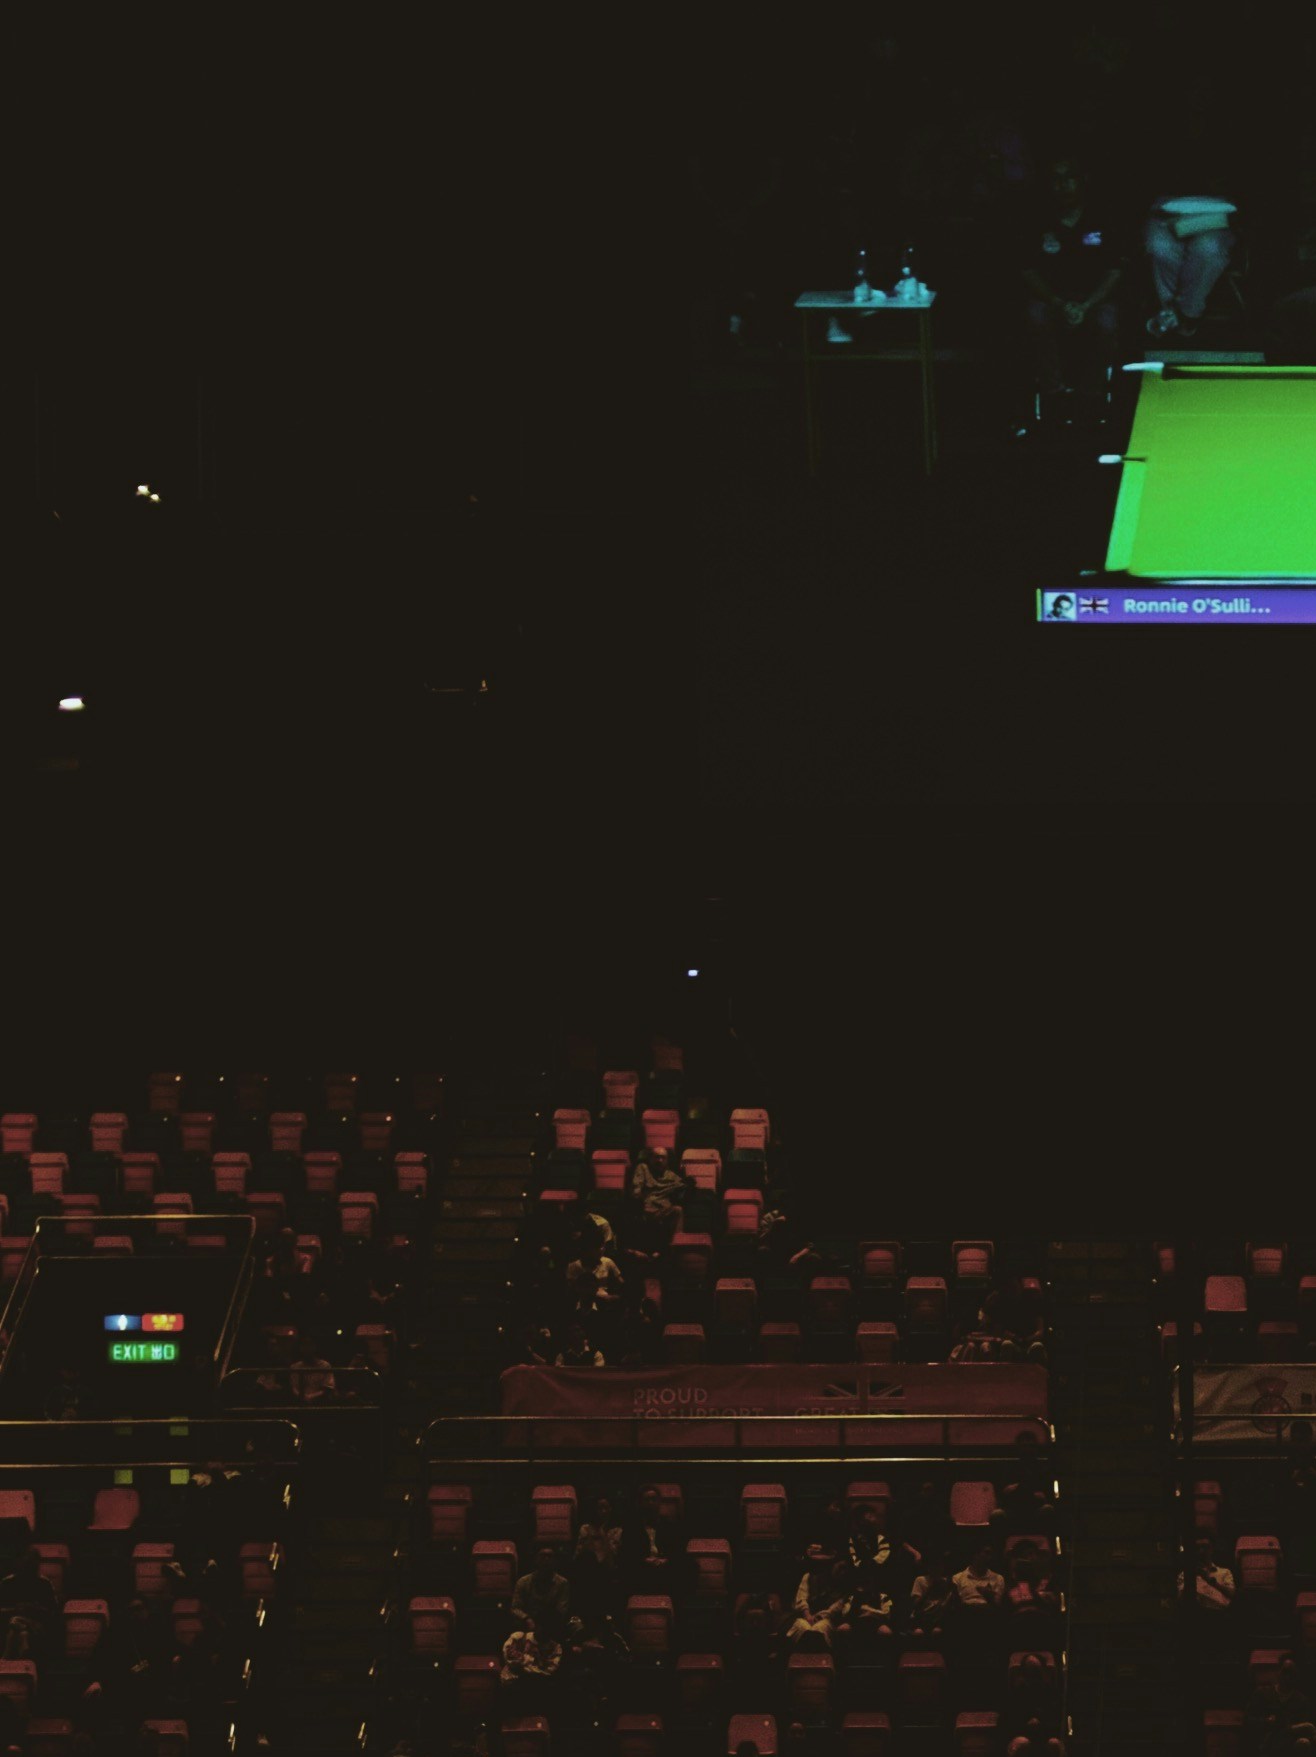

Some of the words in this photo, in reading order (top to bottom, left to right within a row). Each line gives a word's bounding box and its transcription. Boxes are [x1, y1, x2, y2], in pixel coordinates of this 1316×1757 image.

[1124, 598, 1188, 614] Ronnie
[1192, 598, 1271, 614] O'Sulli...
[112, 1343, 146, 1361] EXIT
[151, 1343, 176, 1361] 出口
[633, 1387, 708, 1405] PROUD
